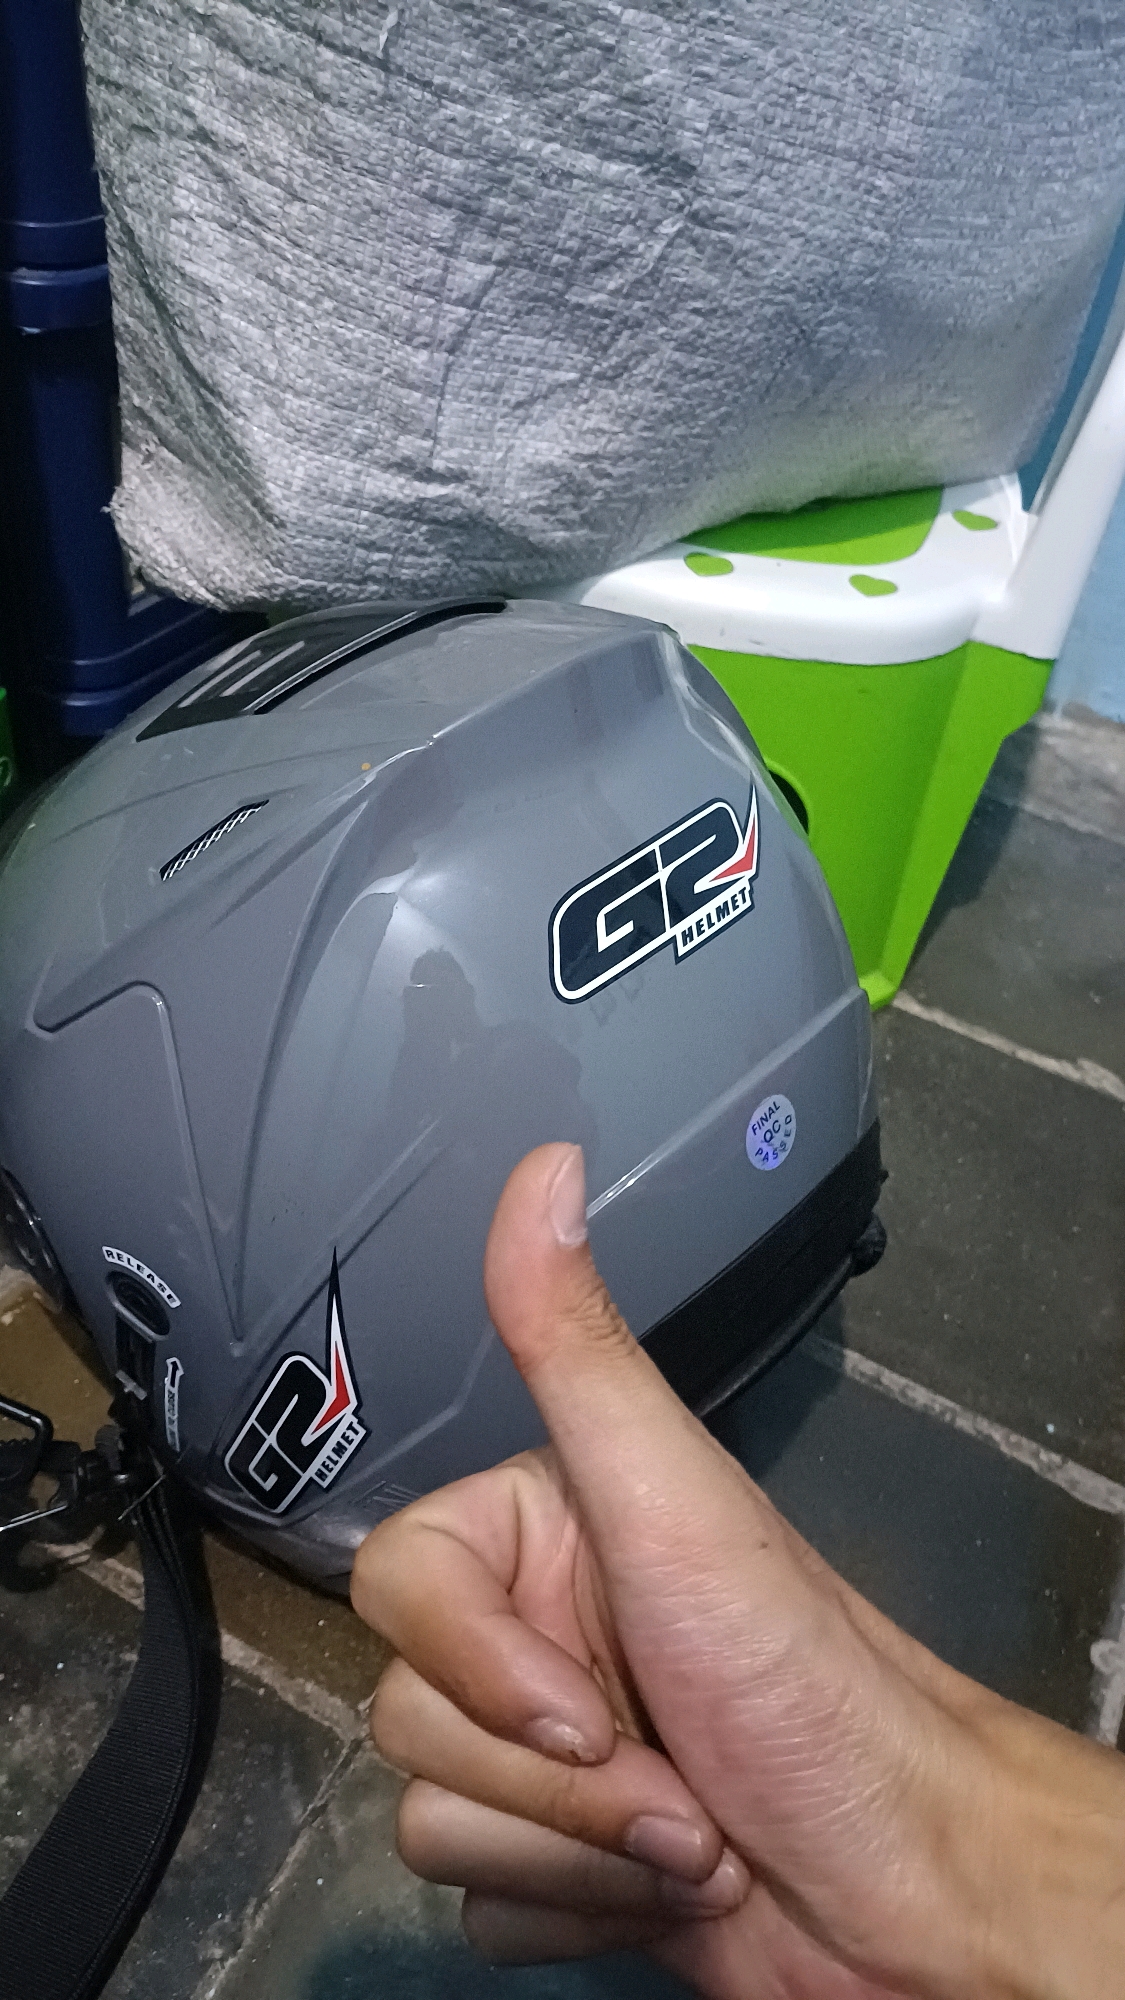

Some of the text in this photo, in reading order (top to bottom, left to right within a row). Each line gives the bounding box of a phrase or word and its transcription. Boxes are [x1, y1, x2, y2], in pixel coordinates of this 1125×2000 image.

[557, 804, 752, 994] G2
[681, 887, 748, 948] HELMET
[751, 1101, 780, 1136] FINAL
[754, 1114, 793, 1163] PASSED
[763, 1119, 781, 1143] QC
[105, 1249, 177, 1304] RELEASE
[227, 1358, 347, 1512] G2
[315, 1421, 360, 1483] HELMET
